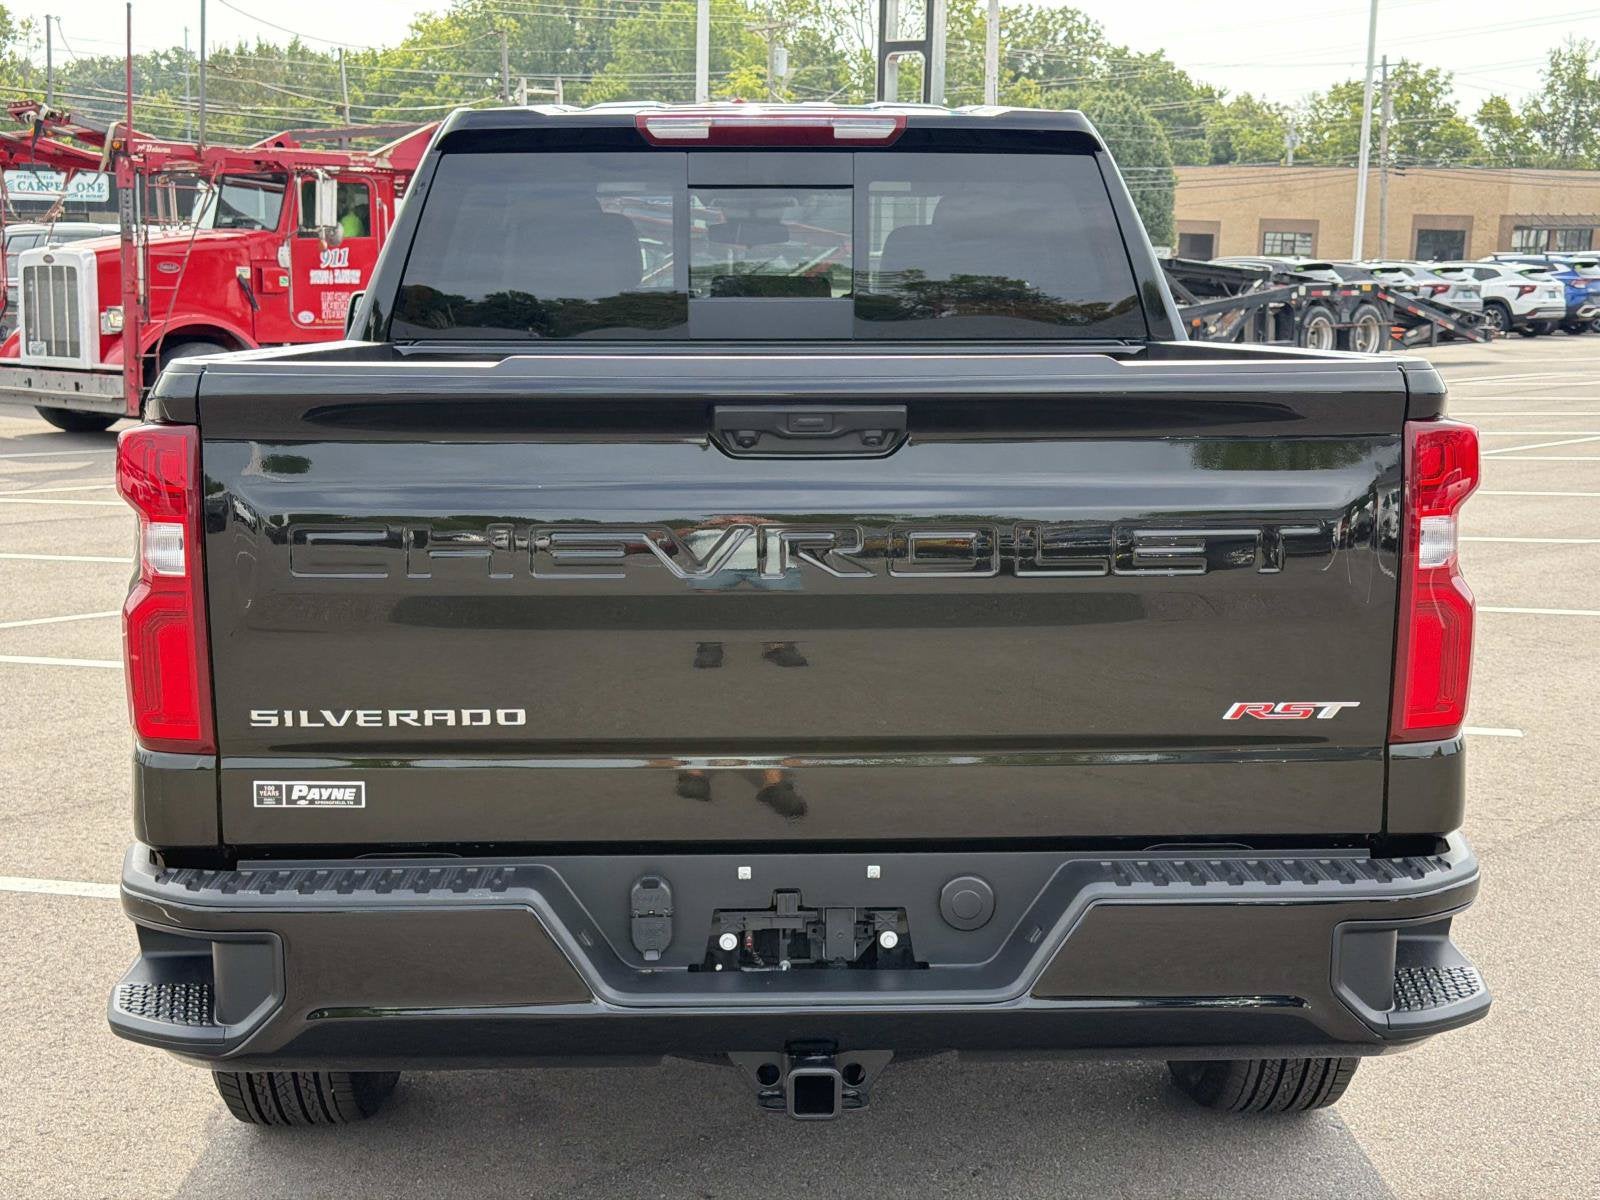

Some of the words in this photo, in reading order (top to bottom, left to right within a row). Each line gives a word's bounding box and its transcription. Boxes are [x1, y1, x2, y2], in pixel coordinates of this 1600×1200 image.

[76, 182, 105, 192] ONE
[320, 247, 350, 269] 911
[289, 523, 1325, 579] CHEVROLET
[250, 708, 527, 727] SILVERADO
[1222, 701, 1361, 720] RST
[291, 785, 356, 800] PAYNE
